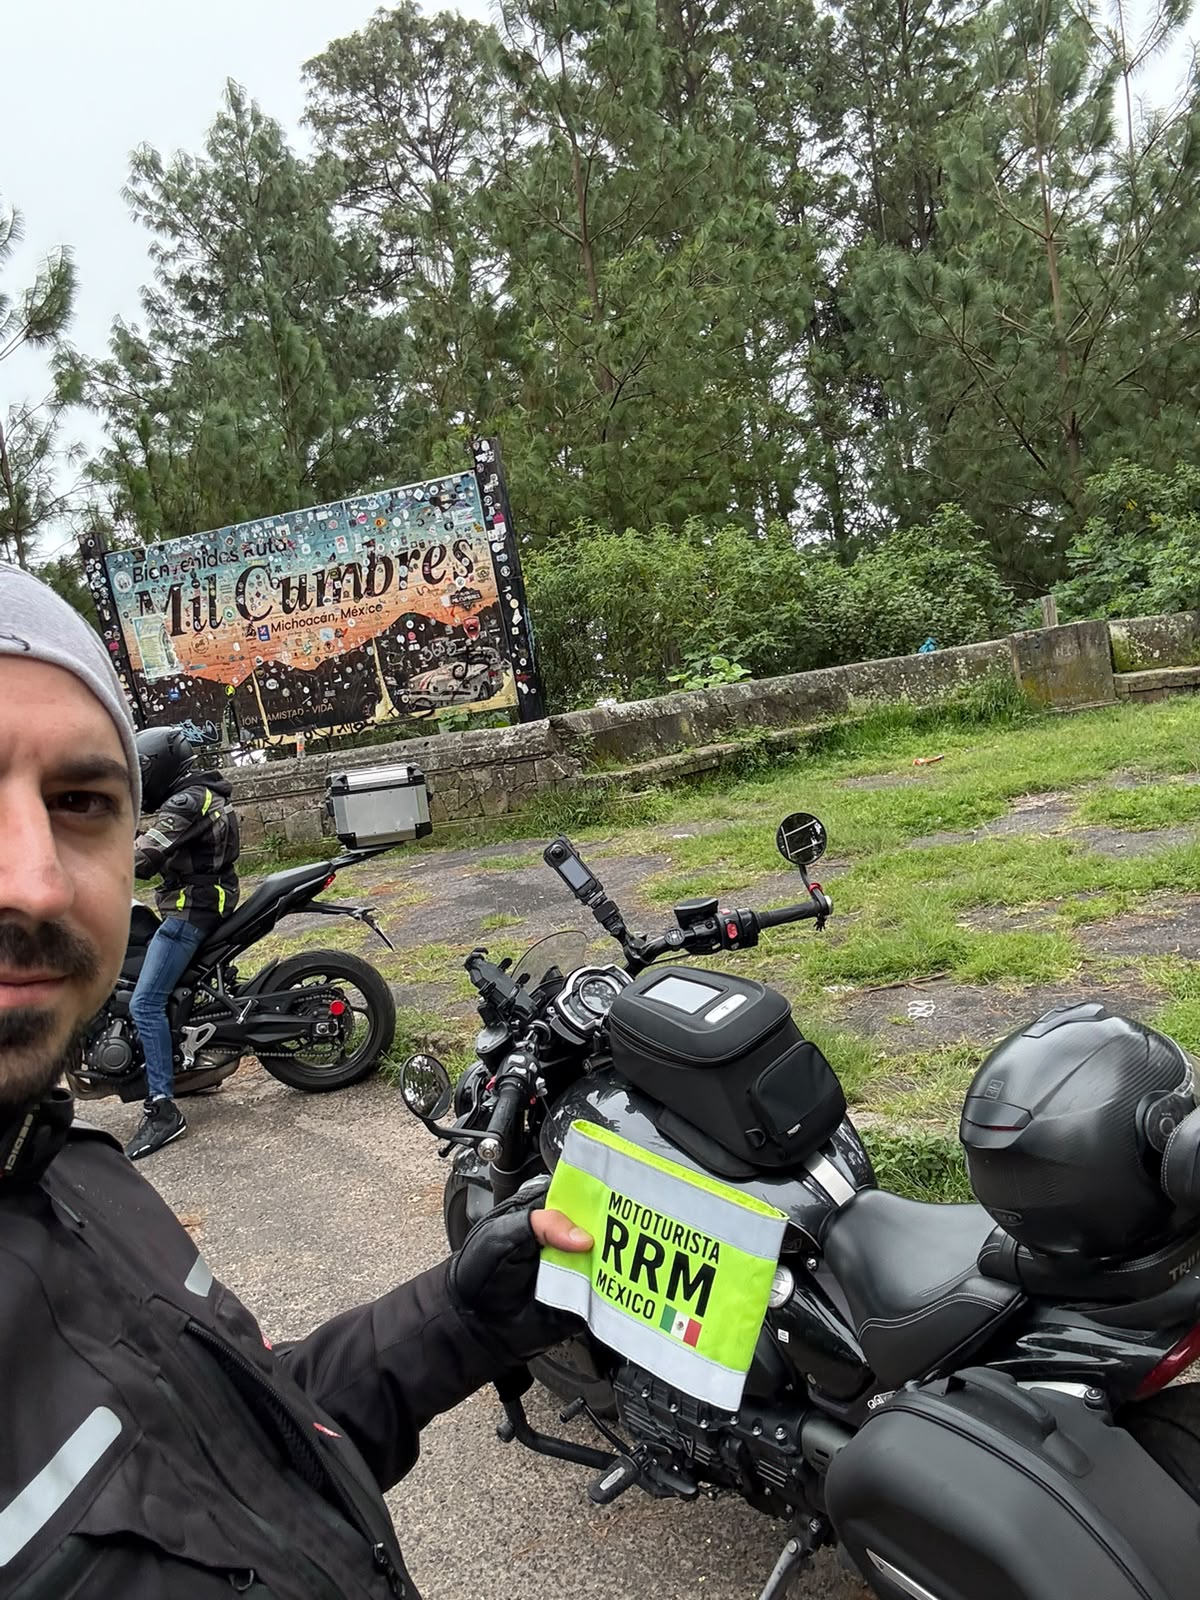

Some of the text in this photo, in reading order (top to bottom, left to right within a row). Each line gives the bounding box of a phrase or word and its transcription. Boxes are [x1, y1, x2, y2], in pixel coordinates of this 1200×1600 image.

[135, 539, 474, 637] Mil Cumbres
[270, 602, 383, 633] Michoacán, México
[267, 708, 304, 721] AMISTAD
[311, 703, 334, 714] VIDA
[608, 1191, 720, 1264] MOTOTURISTA
[596, 1268, 656, 1319] MÉXICO
[601, 1213, 717, 1318] RRM
